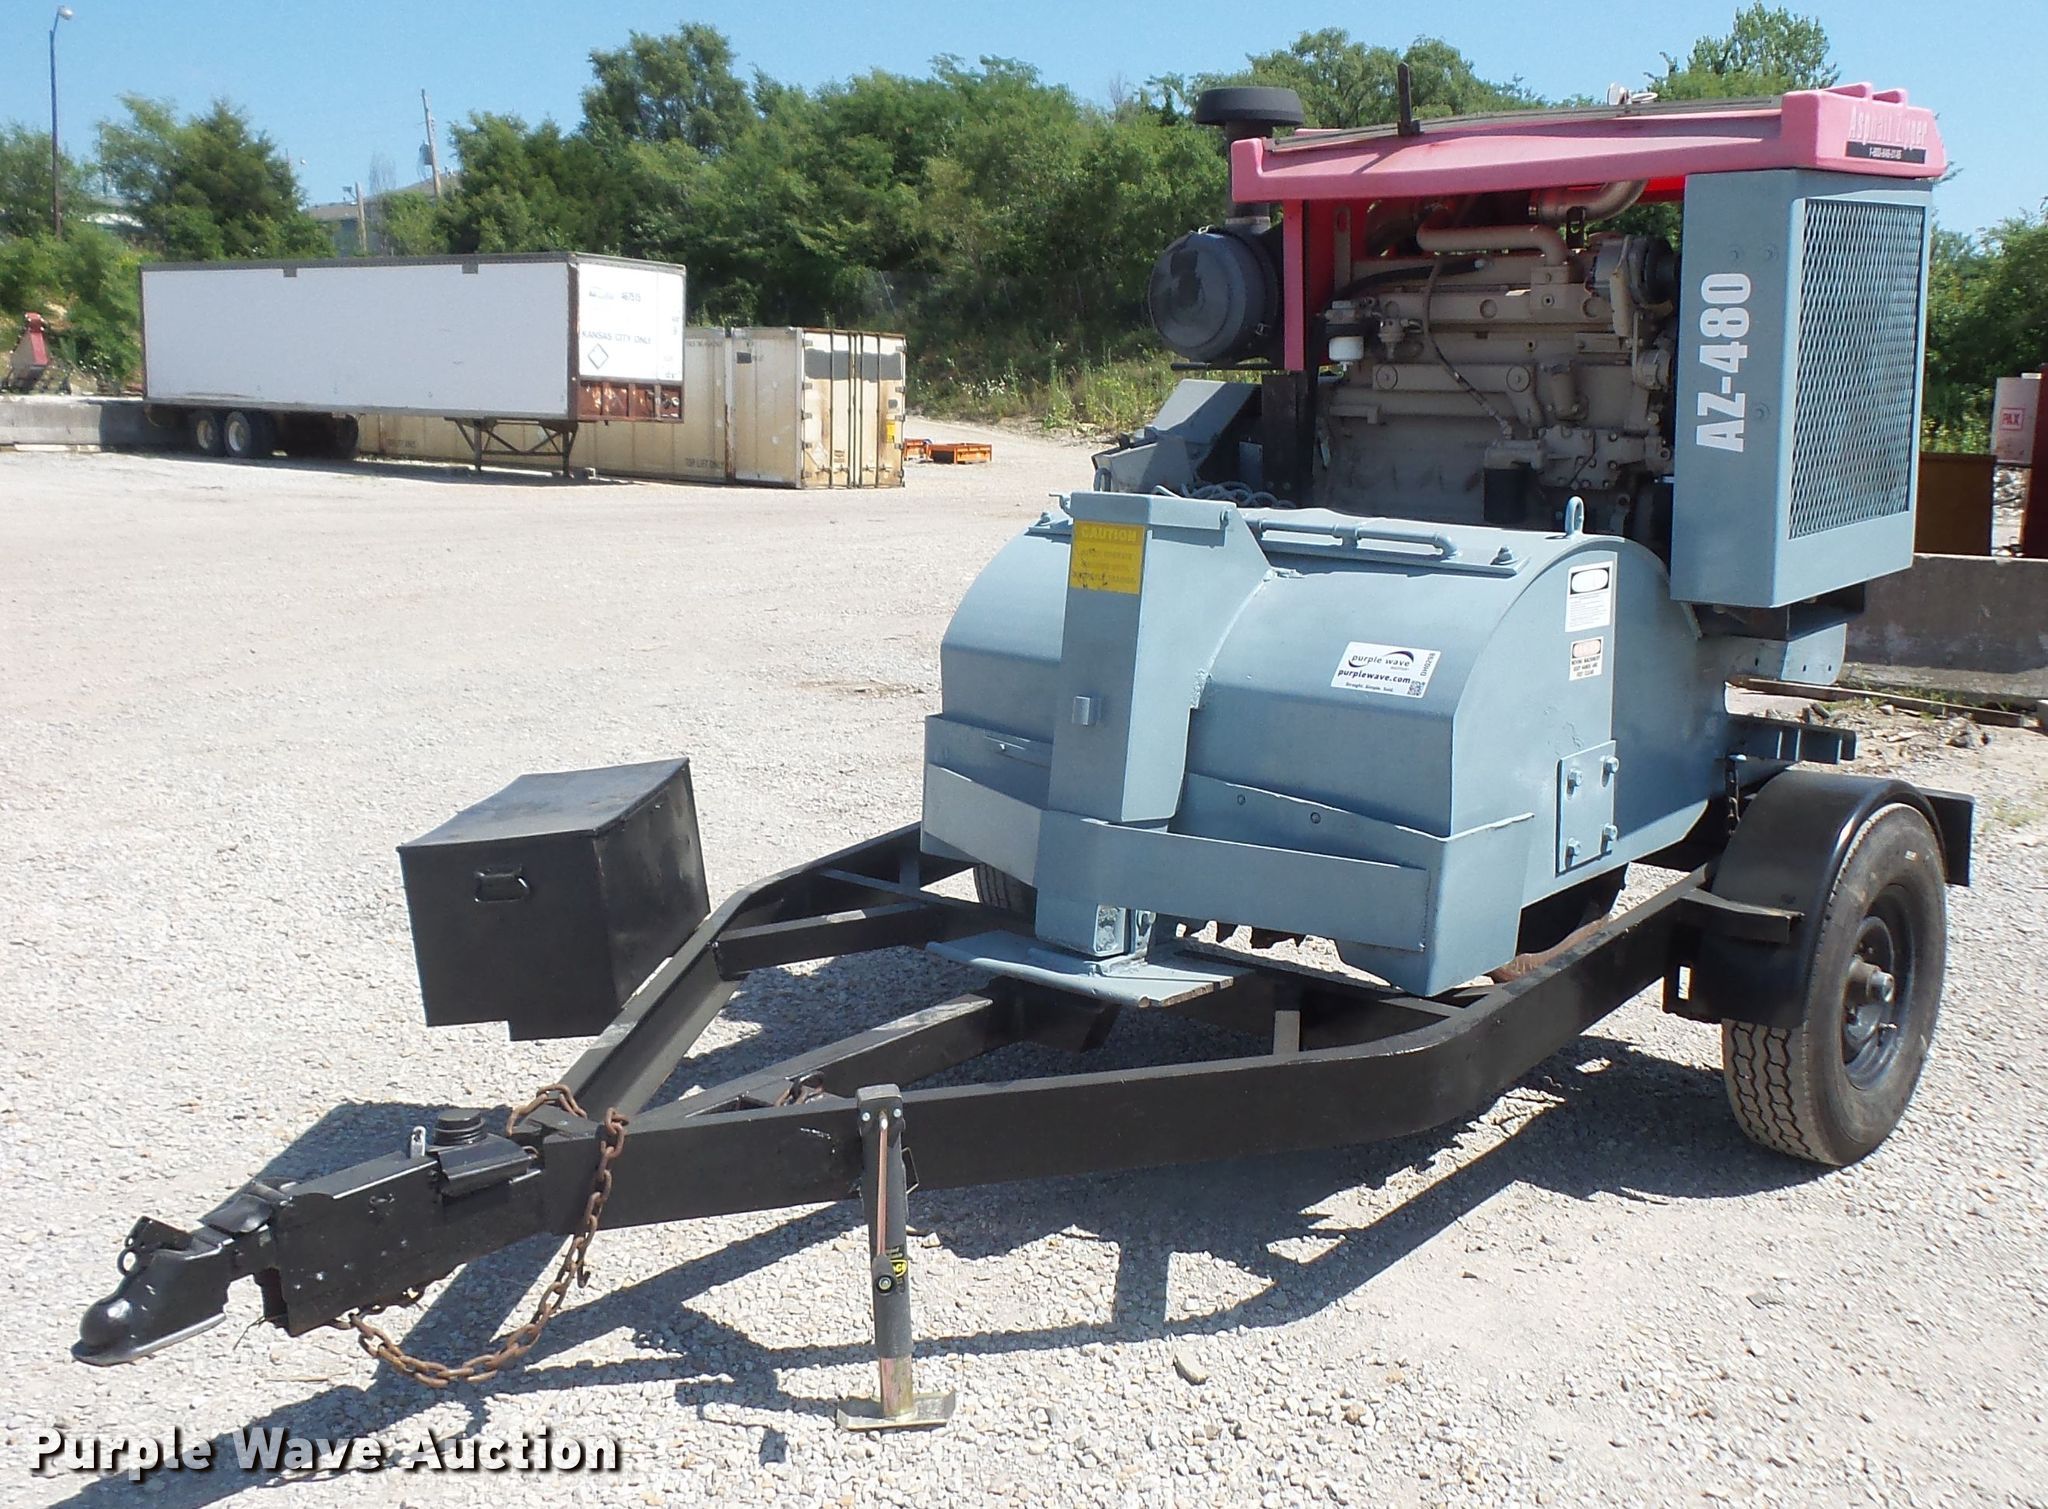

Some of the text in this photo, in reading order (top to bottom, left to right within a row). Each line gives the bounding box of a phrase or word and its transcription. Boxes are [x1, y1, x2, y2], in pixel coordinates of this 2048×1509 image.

[581, 330, 613, 341] KANSAS
[615, 333, 631, 342] CITY
[1696, 273, 1751, 452] AZ-480
[1081, 526, 1137, 542] CAUTION
[1351, 654, 1411, 667] purple wave
[1337, 669, 1411, 684] purplewave.com
